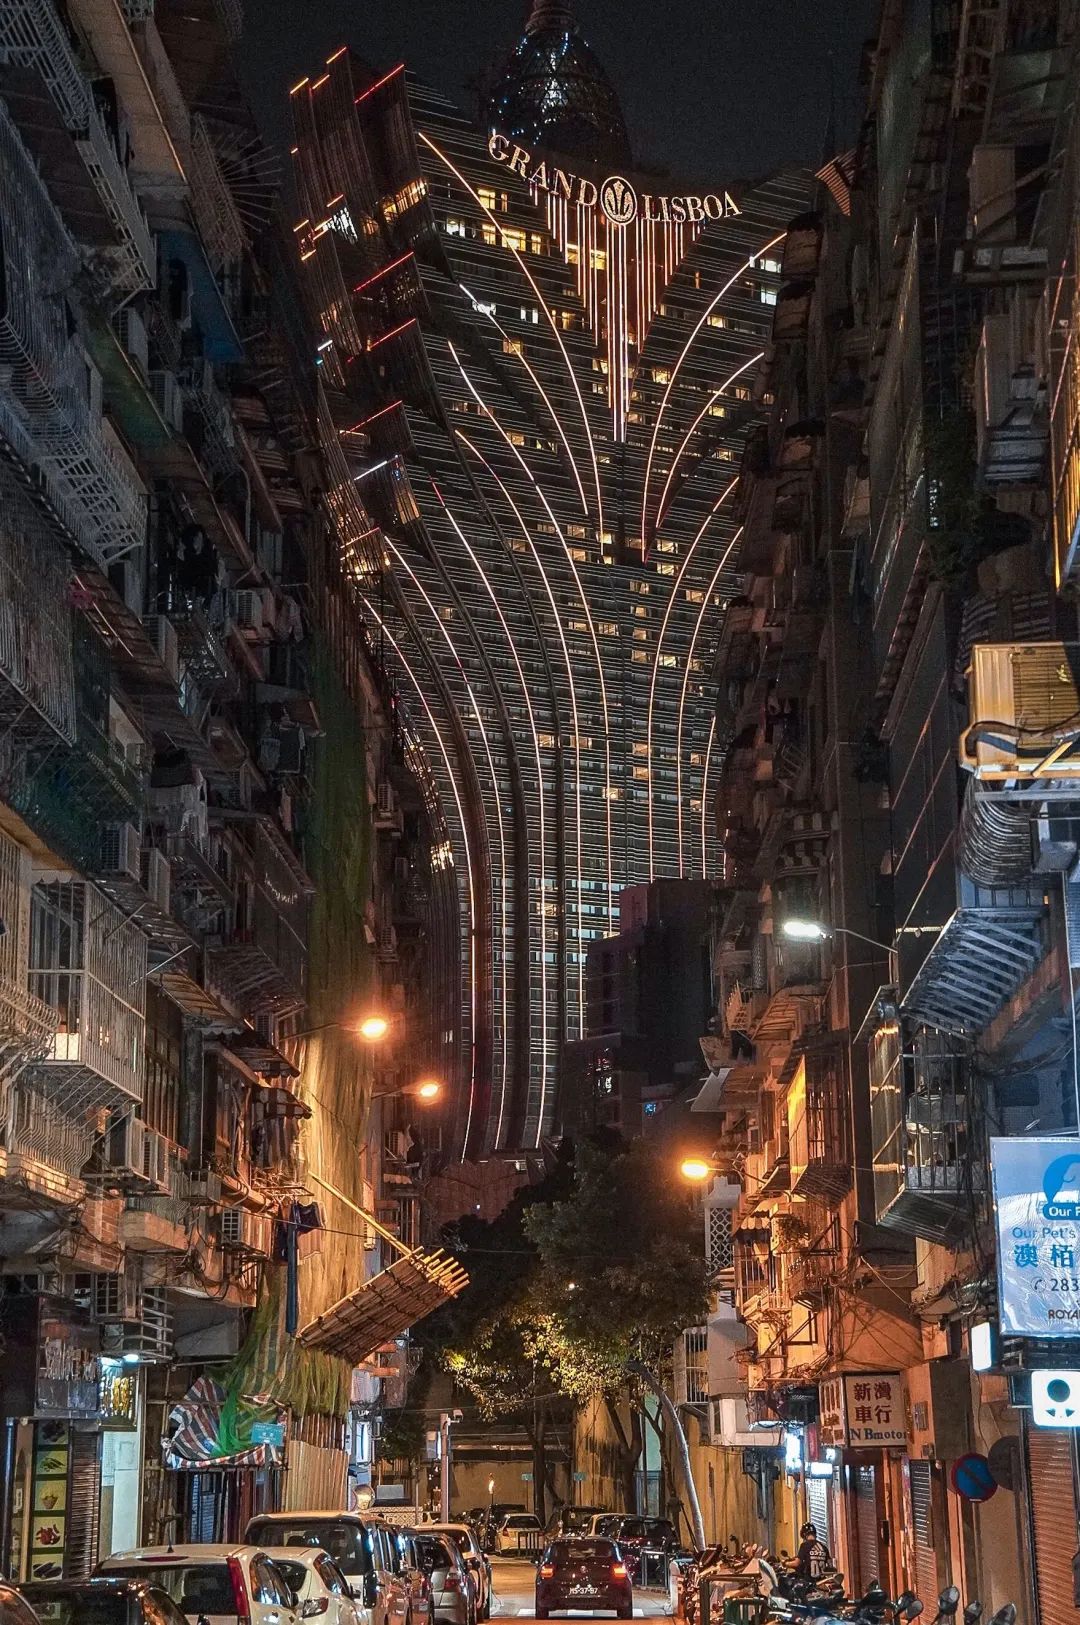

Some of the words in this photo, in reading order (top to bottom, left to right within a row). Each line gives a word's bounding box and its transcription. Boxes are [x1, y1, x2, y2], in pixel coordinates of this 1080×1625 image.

[488, 133, 598, 206] GRAND
[641, 191, 743, 223] LISBOA
[1048, 1206, 1072, 1217] Our
[1012, 1227, 1037, 1239] Our
[1042, 1227, 1076, 1239] Pet's
[1050, 1278, 1080, 1292] 283
[1048, 1309, 1080, 1320] ROYA
[854, 1405, 892, 1424] 車行
[850, 1428, 861, 1441] N
